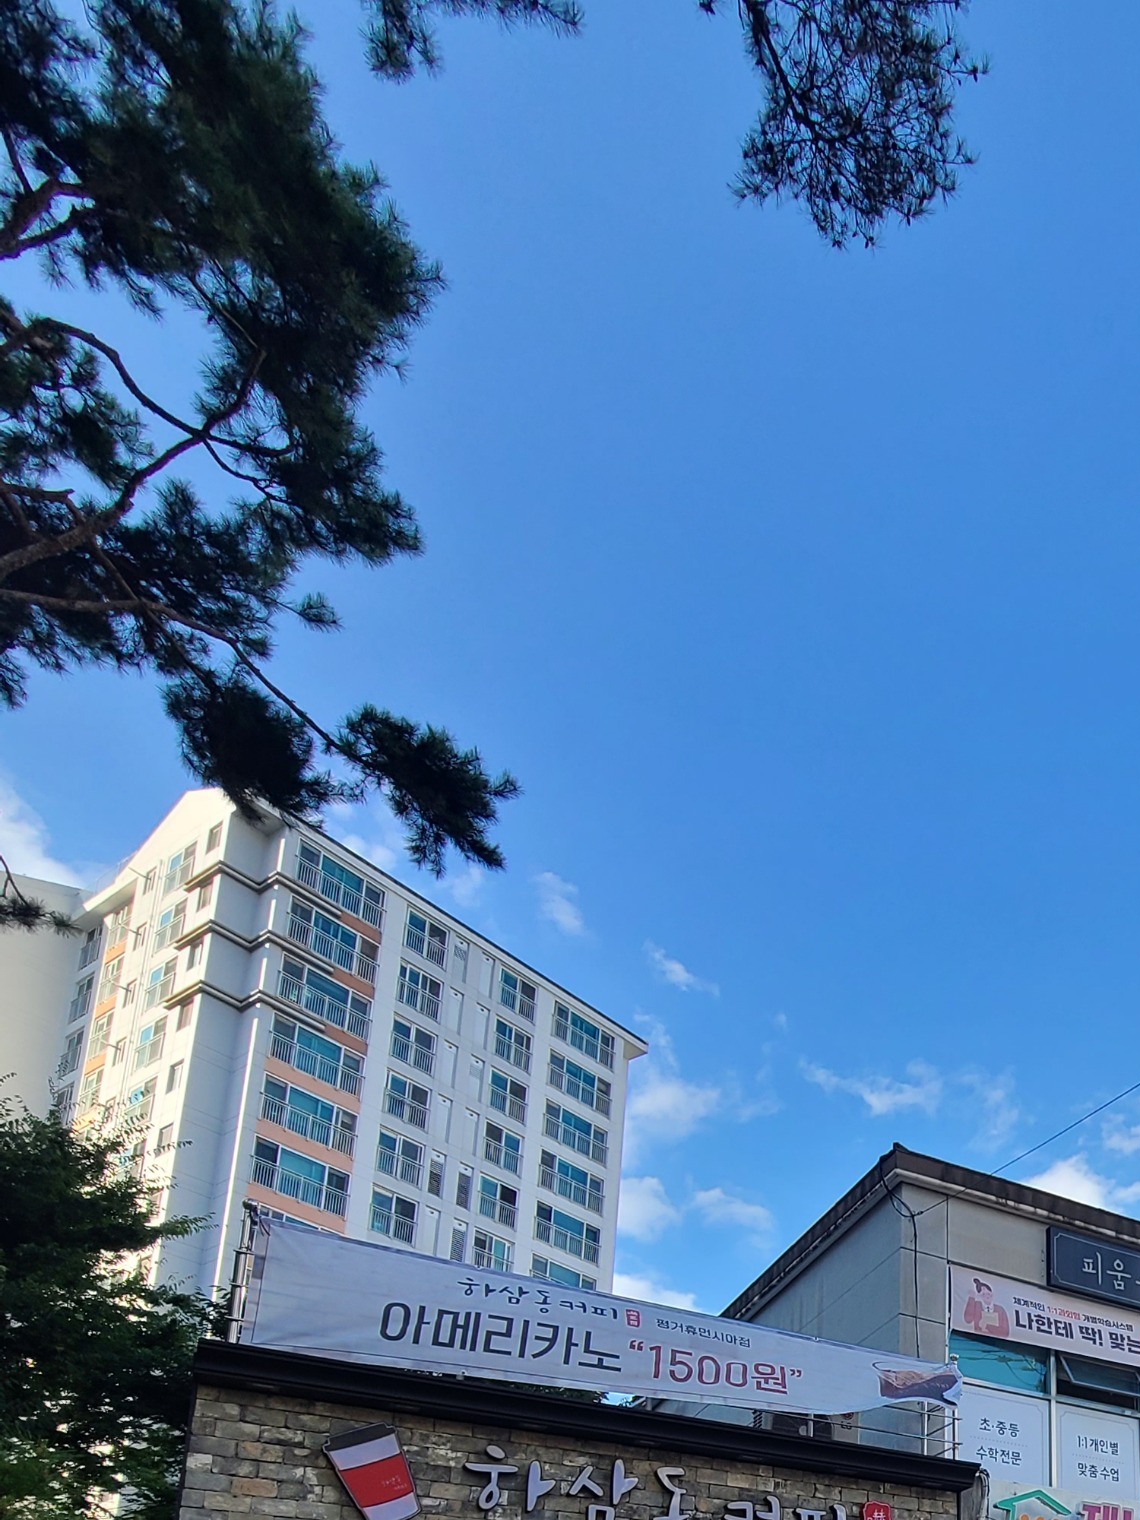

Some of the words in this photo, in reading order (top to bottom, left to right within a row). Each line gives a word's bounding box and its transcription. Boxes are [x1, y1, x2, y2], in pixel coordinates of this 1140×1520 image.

[379, 1300, 622, 1373] 아메리카노
[656, 1316, 752, 1349] 평거휴먼시아점
[1014, 1309, 1075, 1340] 나한테
[1078, 1325, 1104, 1347] 딱!
[1082, 1314, 1134, 1332] 개별학습시스템
